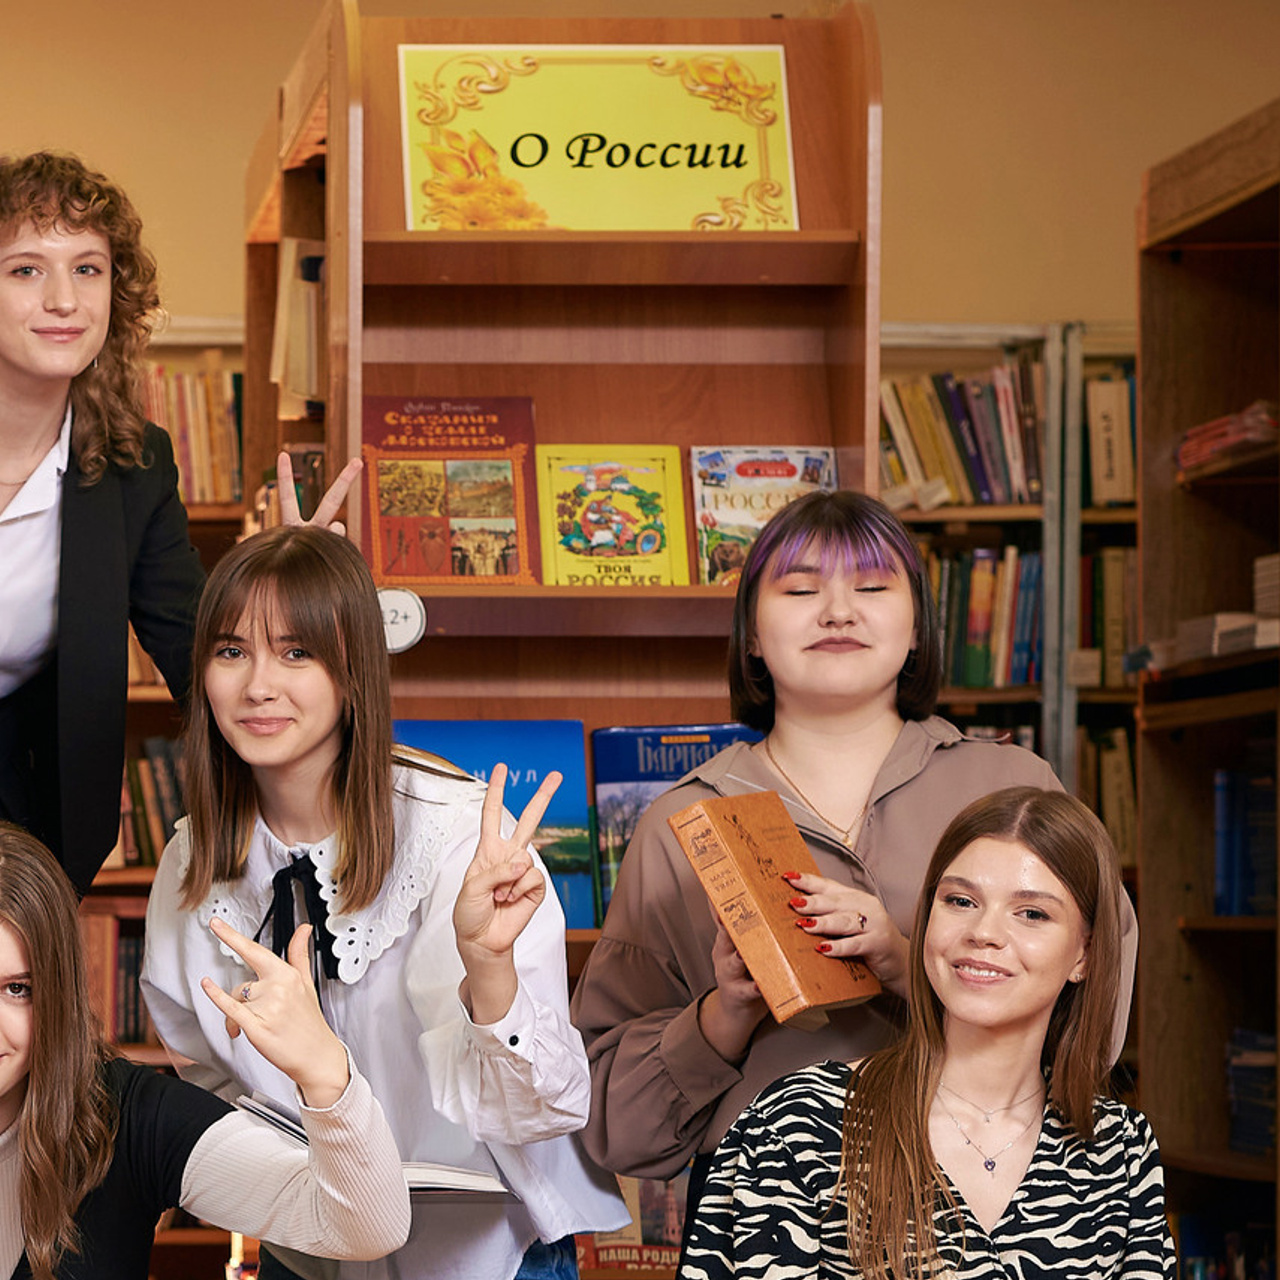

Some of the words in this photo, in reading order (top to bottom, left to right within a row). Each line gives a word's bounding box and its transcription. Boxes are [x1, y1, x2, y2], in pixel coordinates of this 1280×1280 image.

[510, 133, 548, 168] О
[565, 133, 748, 168] России
[599, 1248, 640, 1262] НАША
